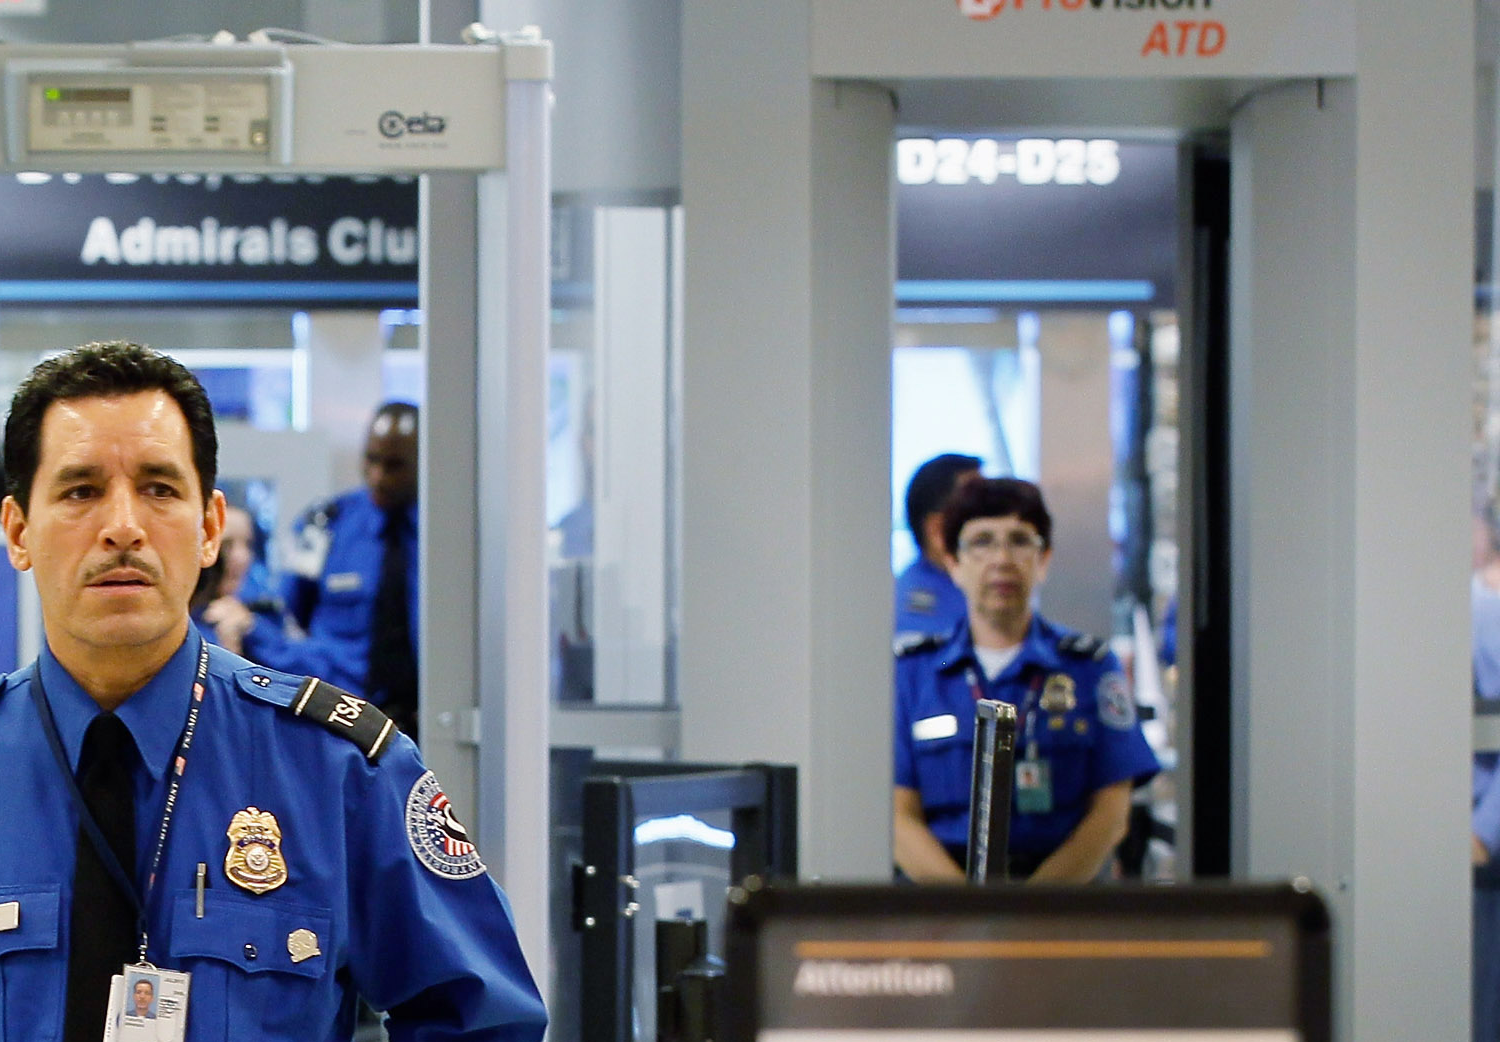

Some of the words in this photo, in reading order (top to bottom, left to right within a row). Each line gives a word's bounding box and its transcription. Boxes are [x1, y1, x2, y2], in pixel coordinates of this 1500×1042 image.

[1141, 21, 1227, 57] ATD
[897, 138, 1121, 185] D24-D25
[80, 217, 319, 266] Admirals
[327, 216, 417, 265] Clu
[328, 694, 366, 727] TSA
[794, 960, 955, 997] Attention
